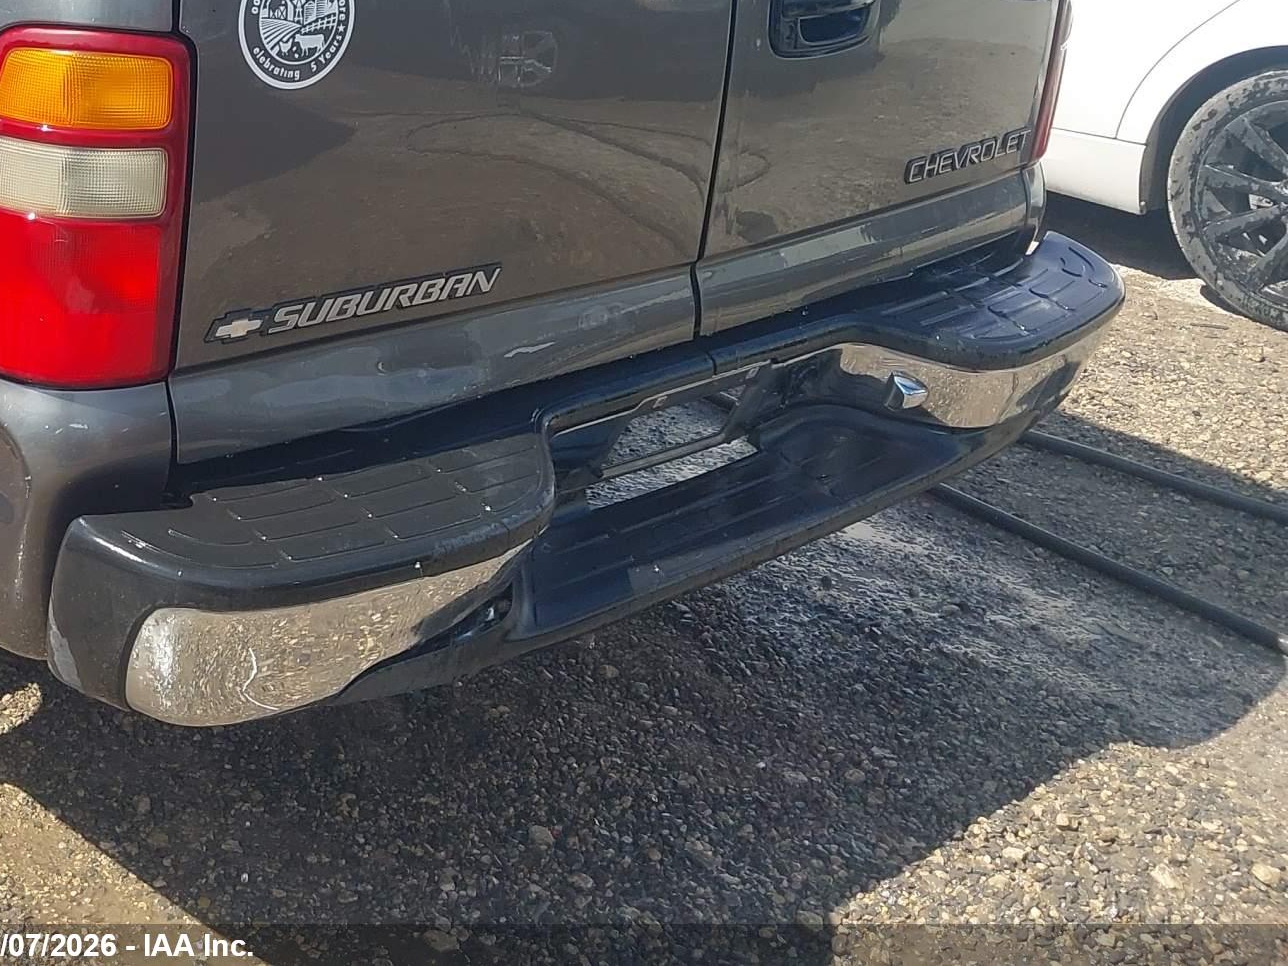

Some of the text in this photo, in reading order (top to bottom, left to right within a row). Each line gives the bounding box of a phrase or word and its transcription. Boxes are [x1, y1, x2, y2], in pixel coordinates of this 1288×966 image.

[318, 34, 343, 65] Years
[908, 128, 1033, 183] CHEVROLET
[267, 267, 503, 335] SUBURBAN
